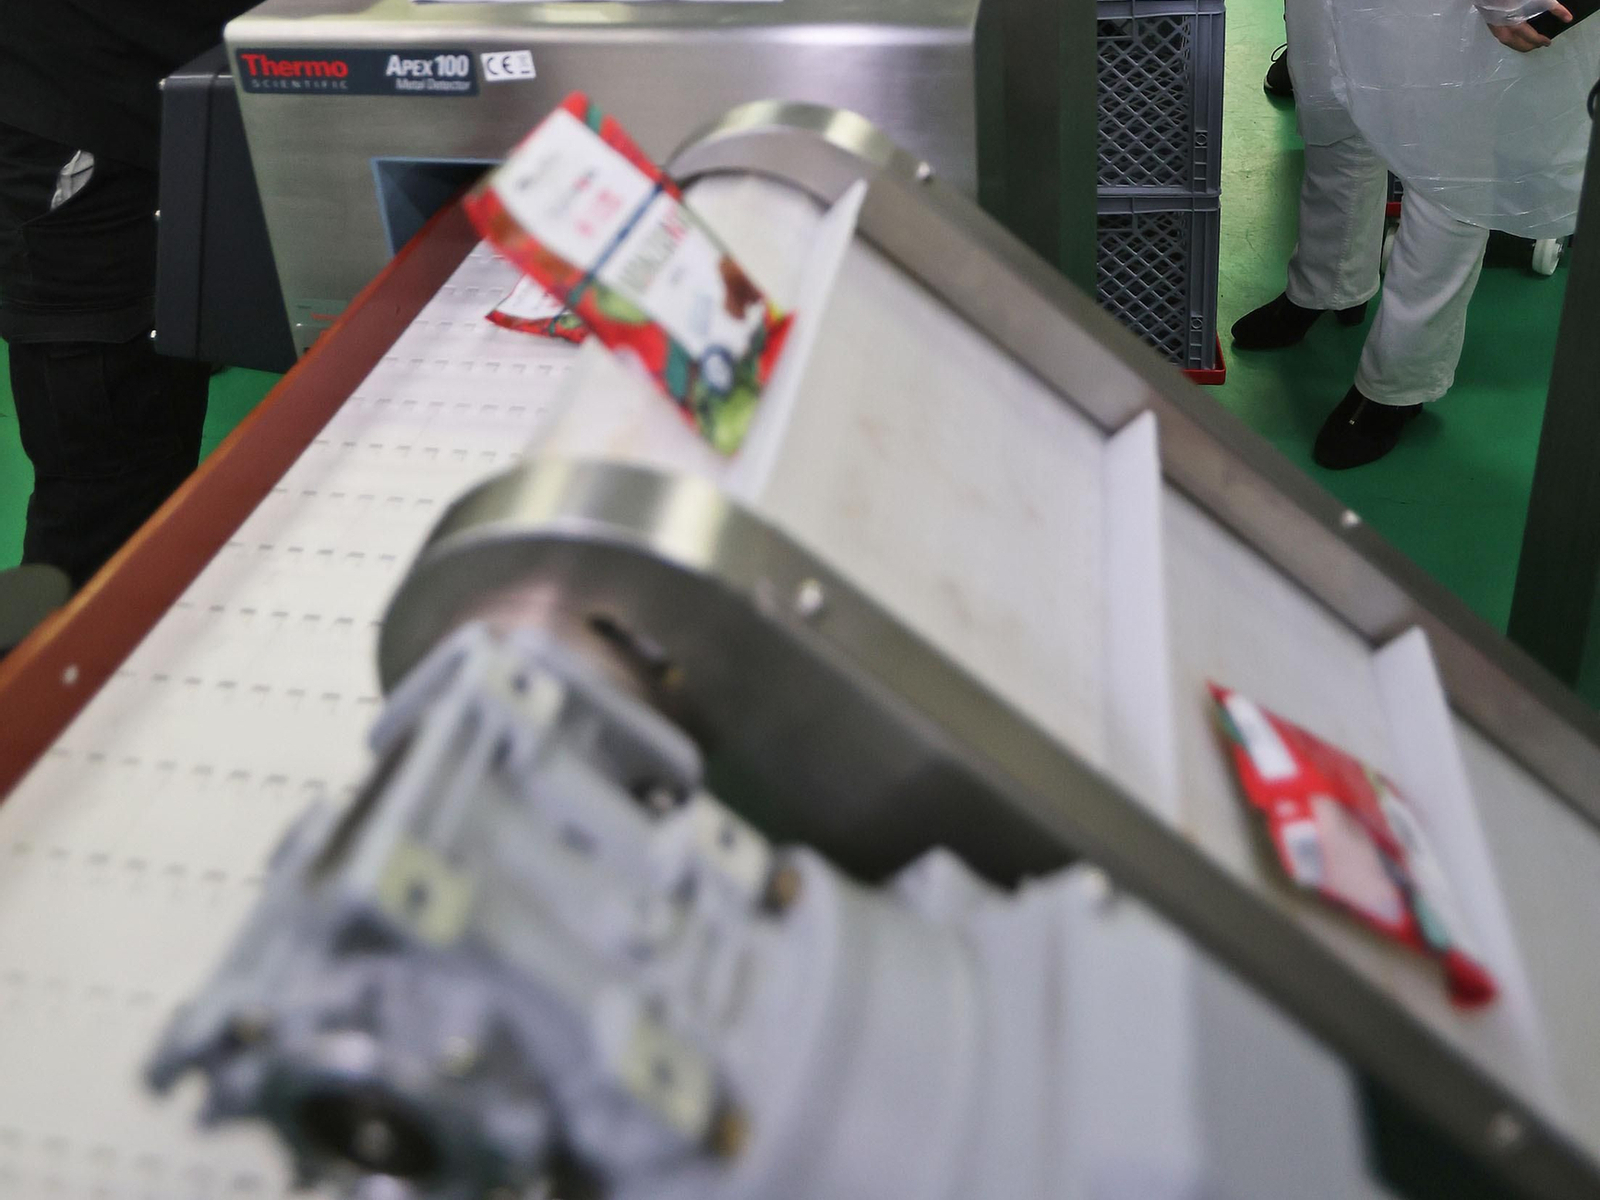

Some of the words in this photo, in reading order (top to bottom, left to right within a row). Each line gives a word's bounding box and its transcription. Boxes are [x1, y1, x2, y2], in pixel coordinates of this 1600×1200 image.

[241, 53, 348, 78] Thermo
[434, 54, 470, 77] 100
[251, 79, 348, 89] SCIENTIFIC
[396, 78, 425, 90] Metal
[427, 79, 471, 91] Detector
